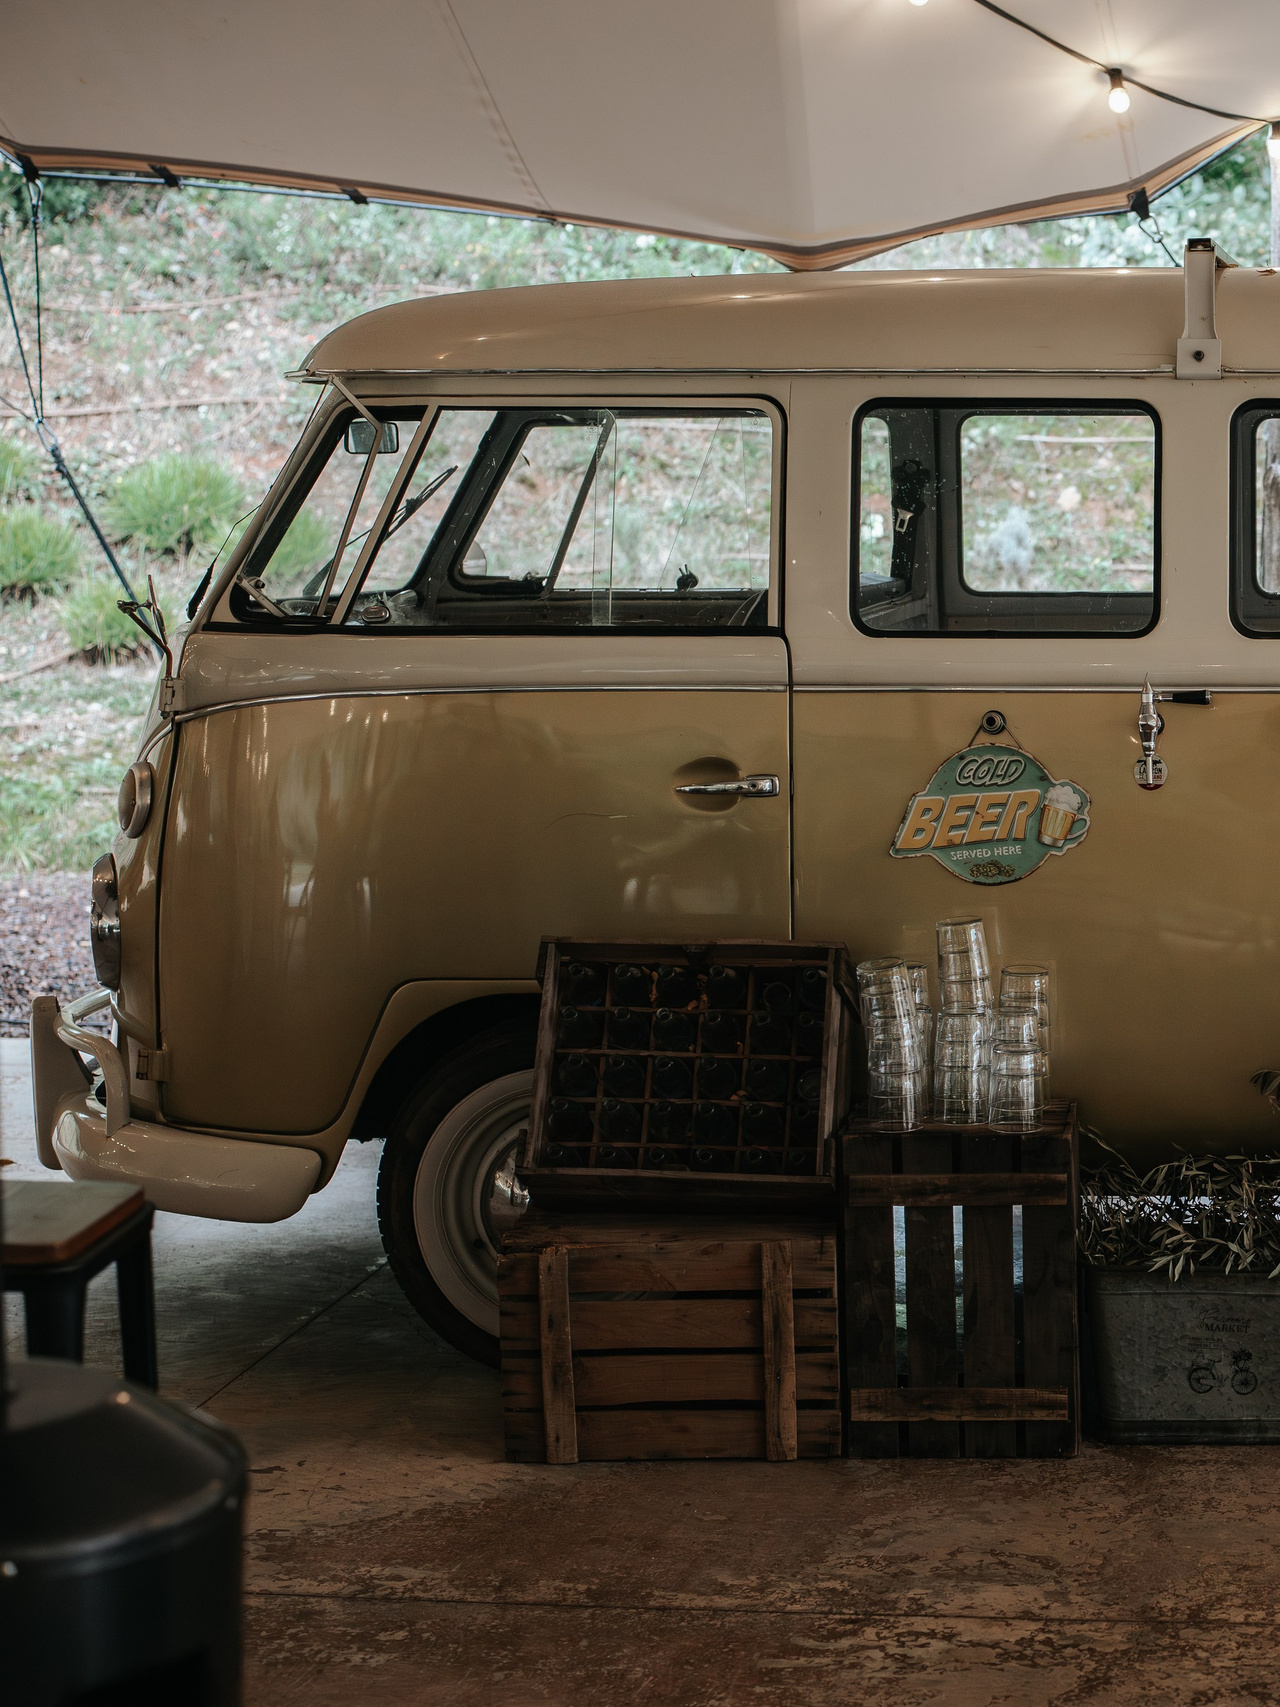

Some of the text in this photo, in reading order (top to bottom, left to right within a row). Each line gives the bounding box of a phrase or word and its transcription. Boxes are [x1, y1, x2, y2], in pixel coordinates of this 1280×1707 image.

[956, 755, 1027, 787] COLD
[895, 789, 1042, 850] BEER
[950, 845, 1022, 861] SERVED HERE
[1204, 1322, 1251, 1334] MARKET
